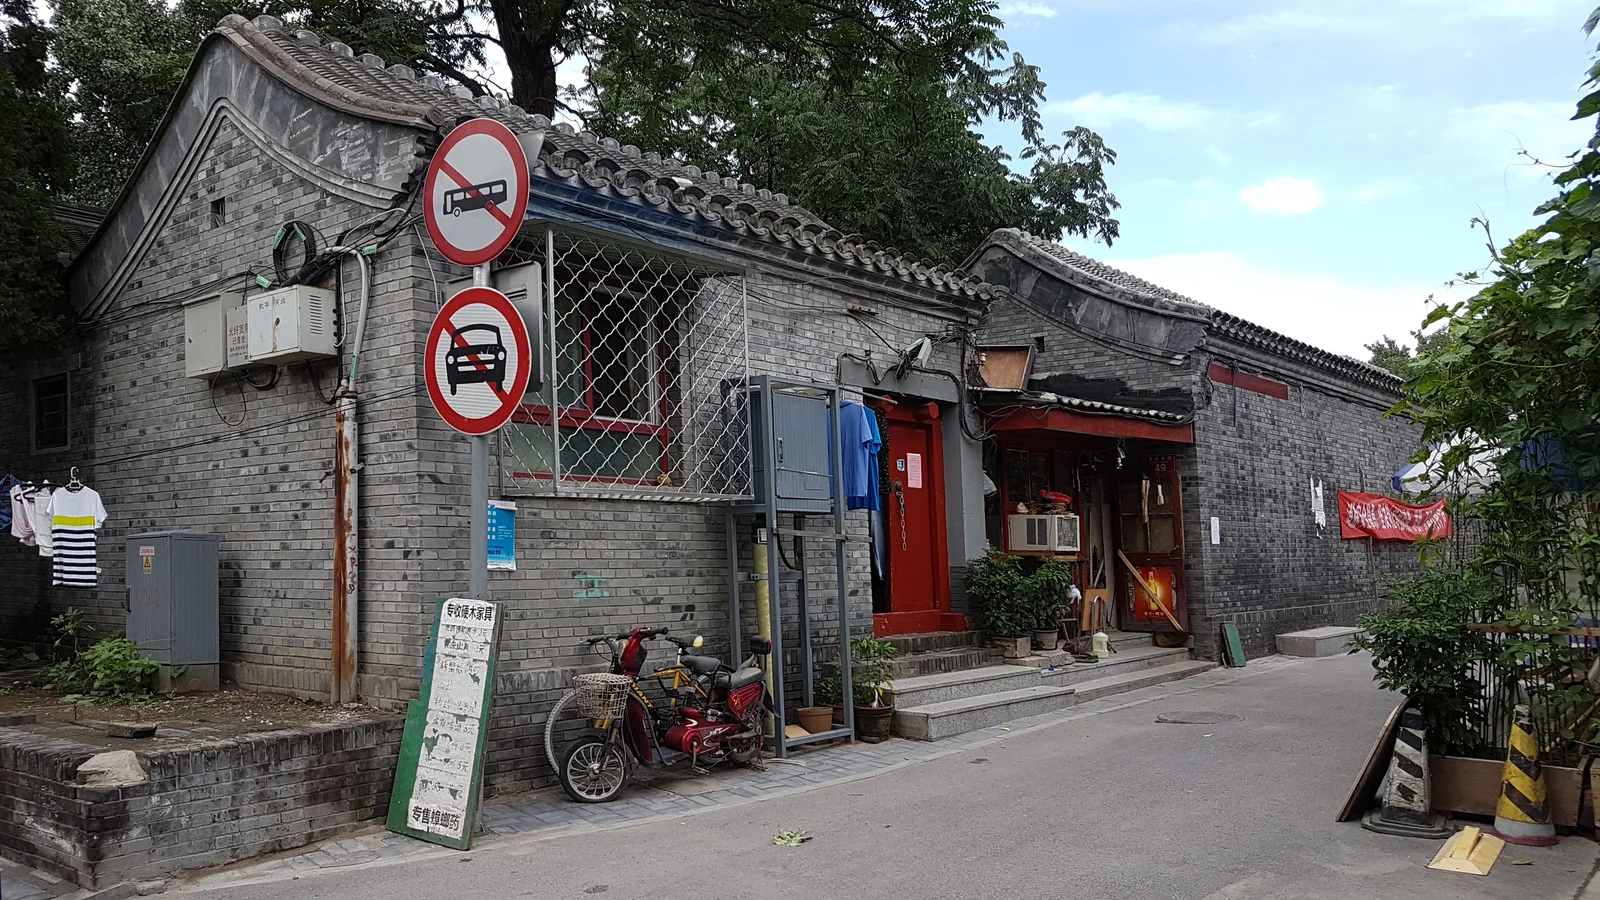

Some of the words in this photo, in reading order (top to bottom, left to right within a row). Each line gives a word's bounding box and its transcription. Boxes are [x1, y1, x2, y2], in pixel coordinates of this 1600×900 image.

[1154, 464, 1166, 472] 49
[447, 604, 493, 621] 专收硬木家具
[412, 805, 460, 831] 专售蟑螂药
